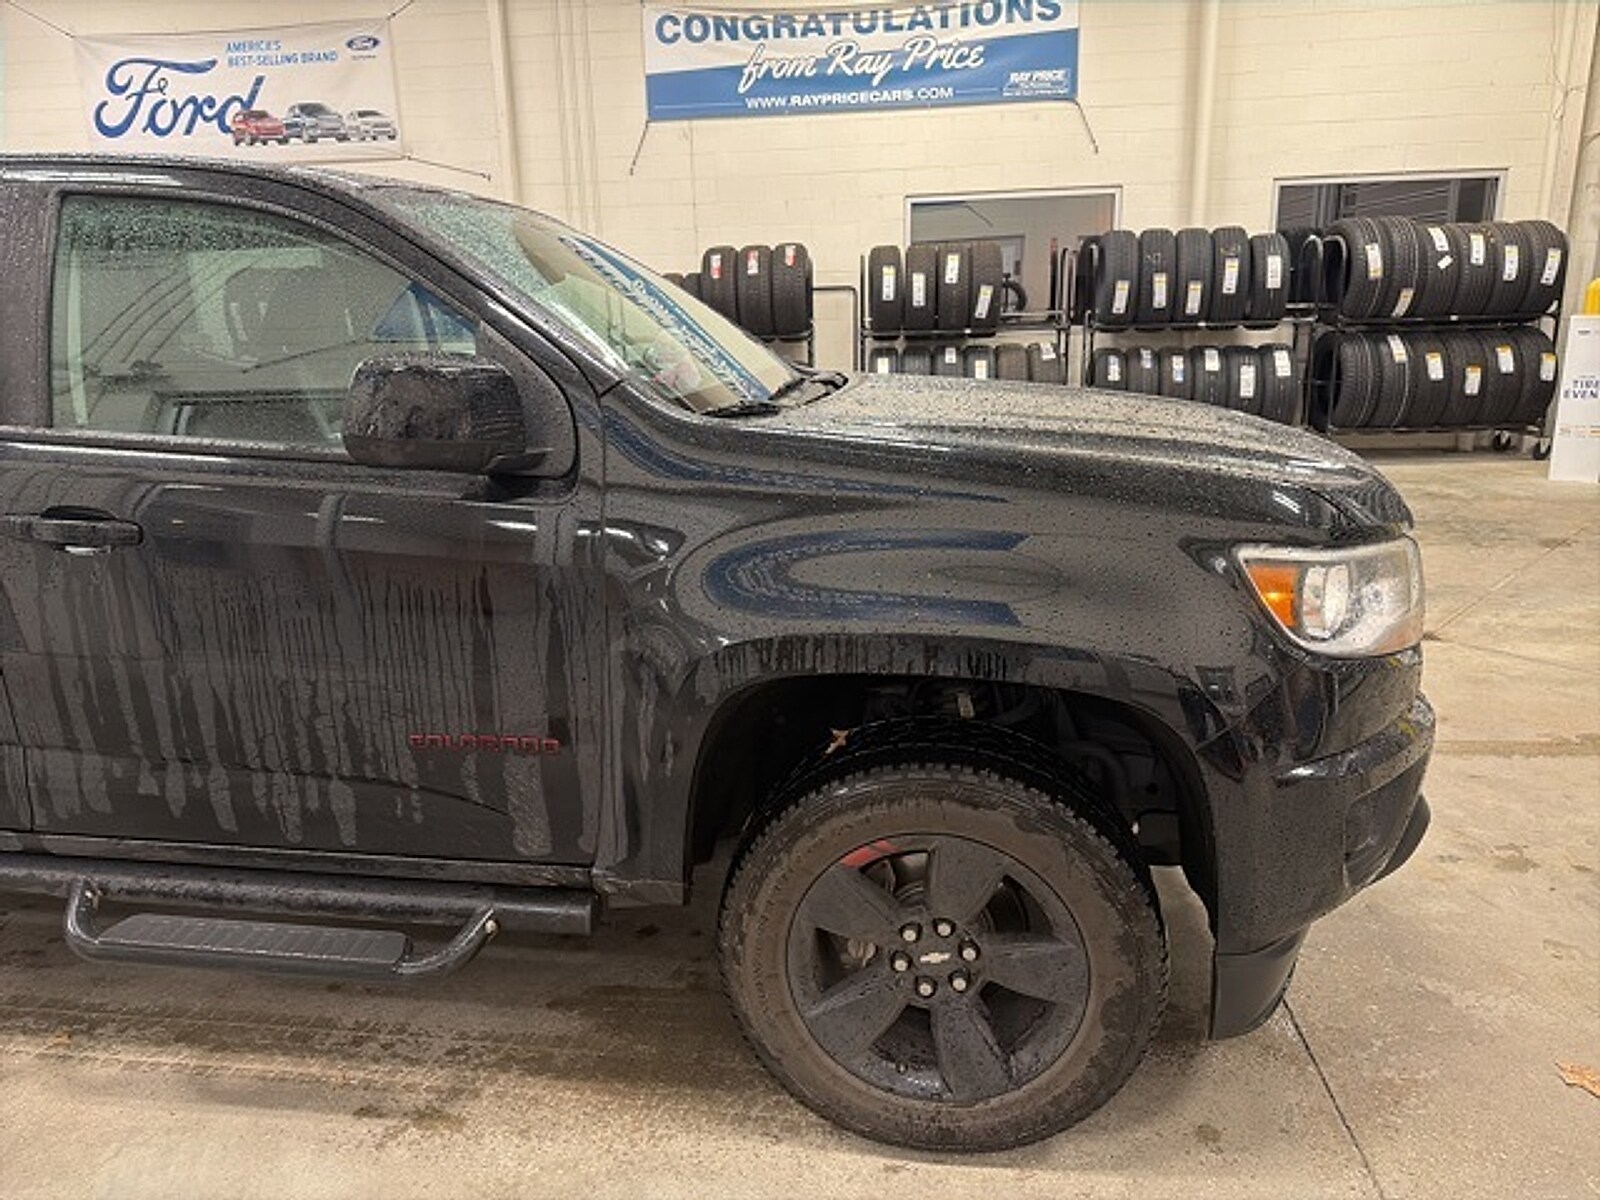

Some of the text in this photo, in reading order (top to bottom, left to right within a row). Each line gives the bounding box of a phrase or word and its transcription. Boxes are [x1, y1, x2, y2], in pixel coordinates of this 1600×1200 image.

[655, 0, 1062, 44] CONGRATULATIONS
[228, 54, 299, 67] BEST-SELLING
[300, 51, 338, 63] BRAND
[738, 35, 984, 93] from Ray Price
[94, 58, 266, 138] Ford
[745, 87, 954, 109] WWW.RAYPRICECARS.COM
[409, 734, 560, 755] COLORADO
